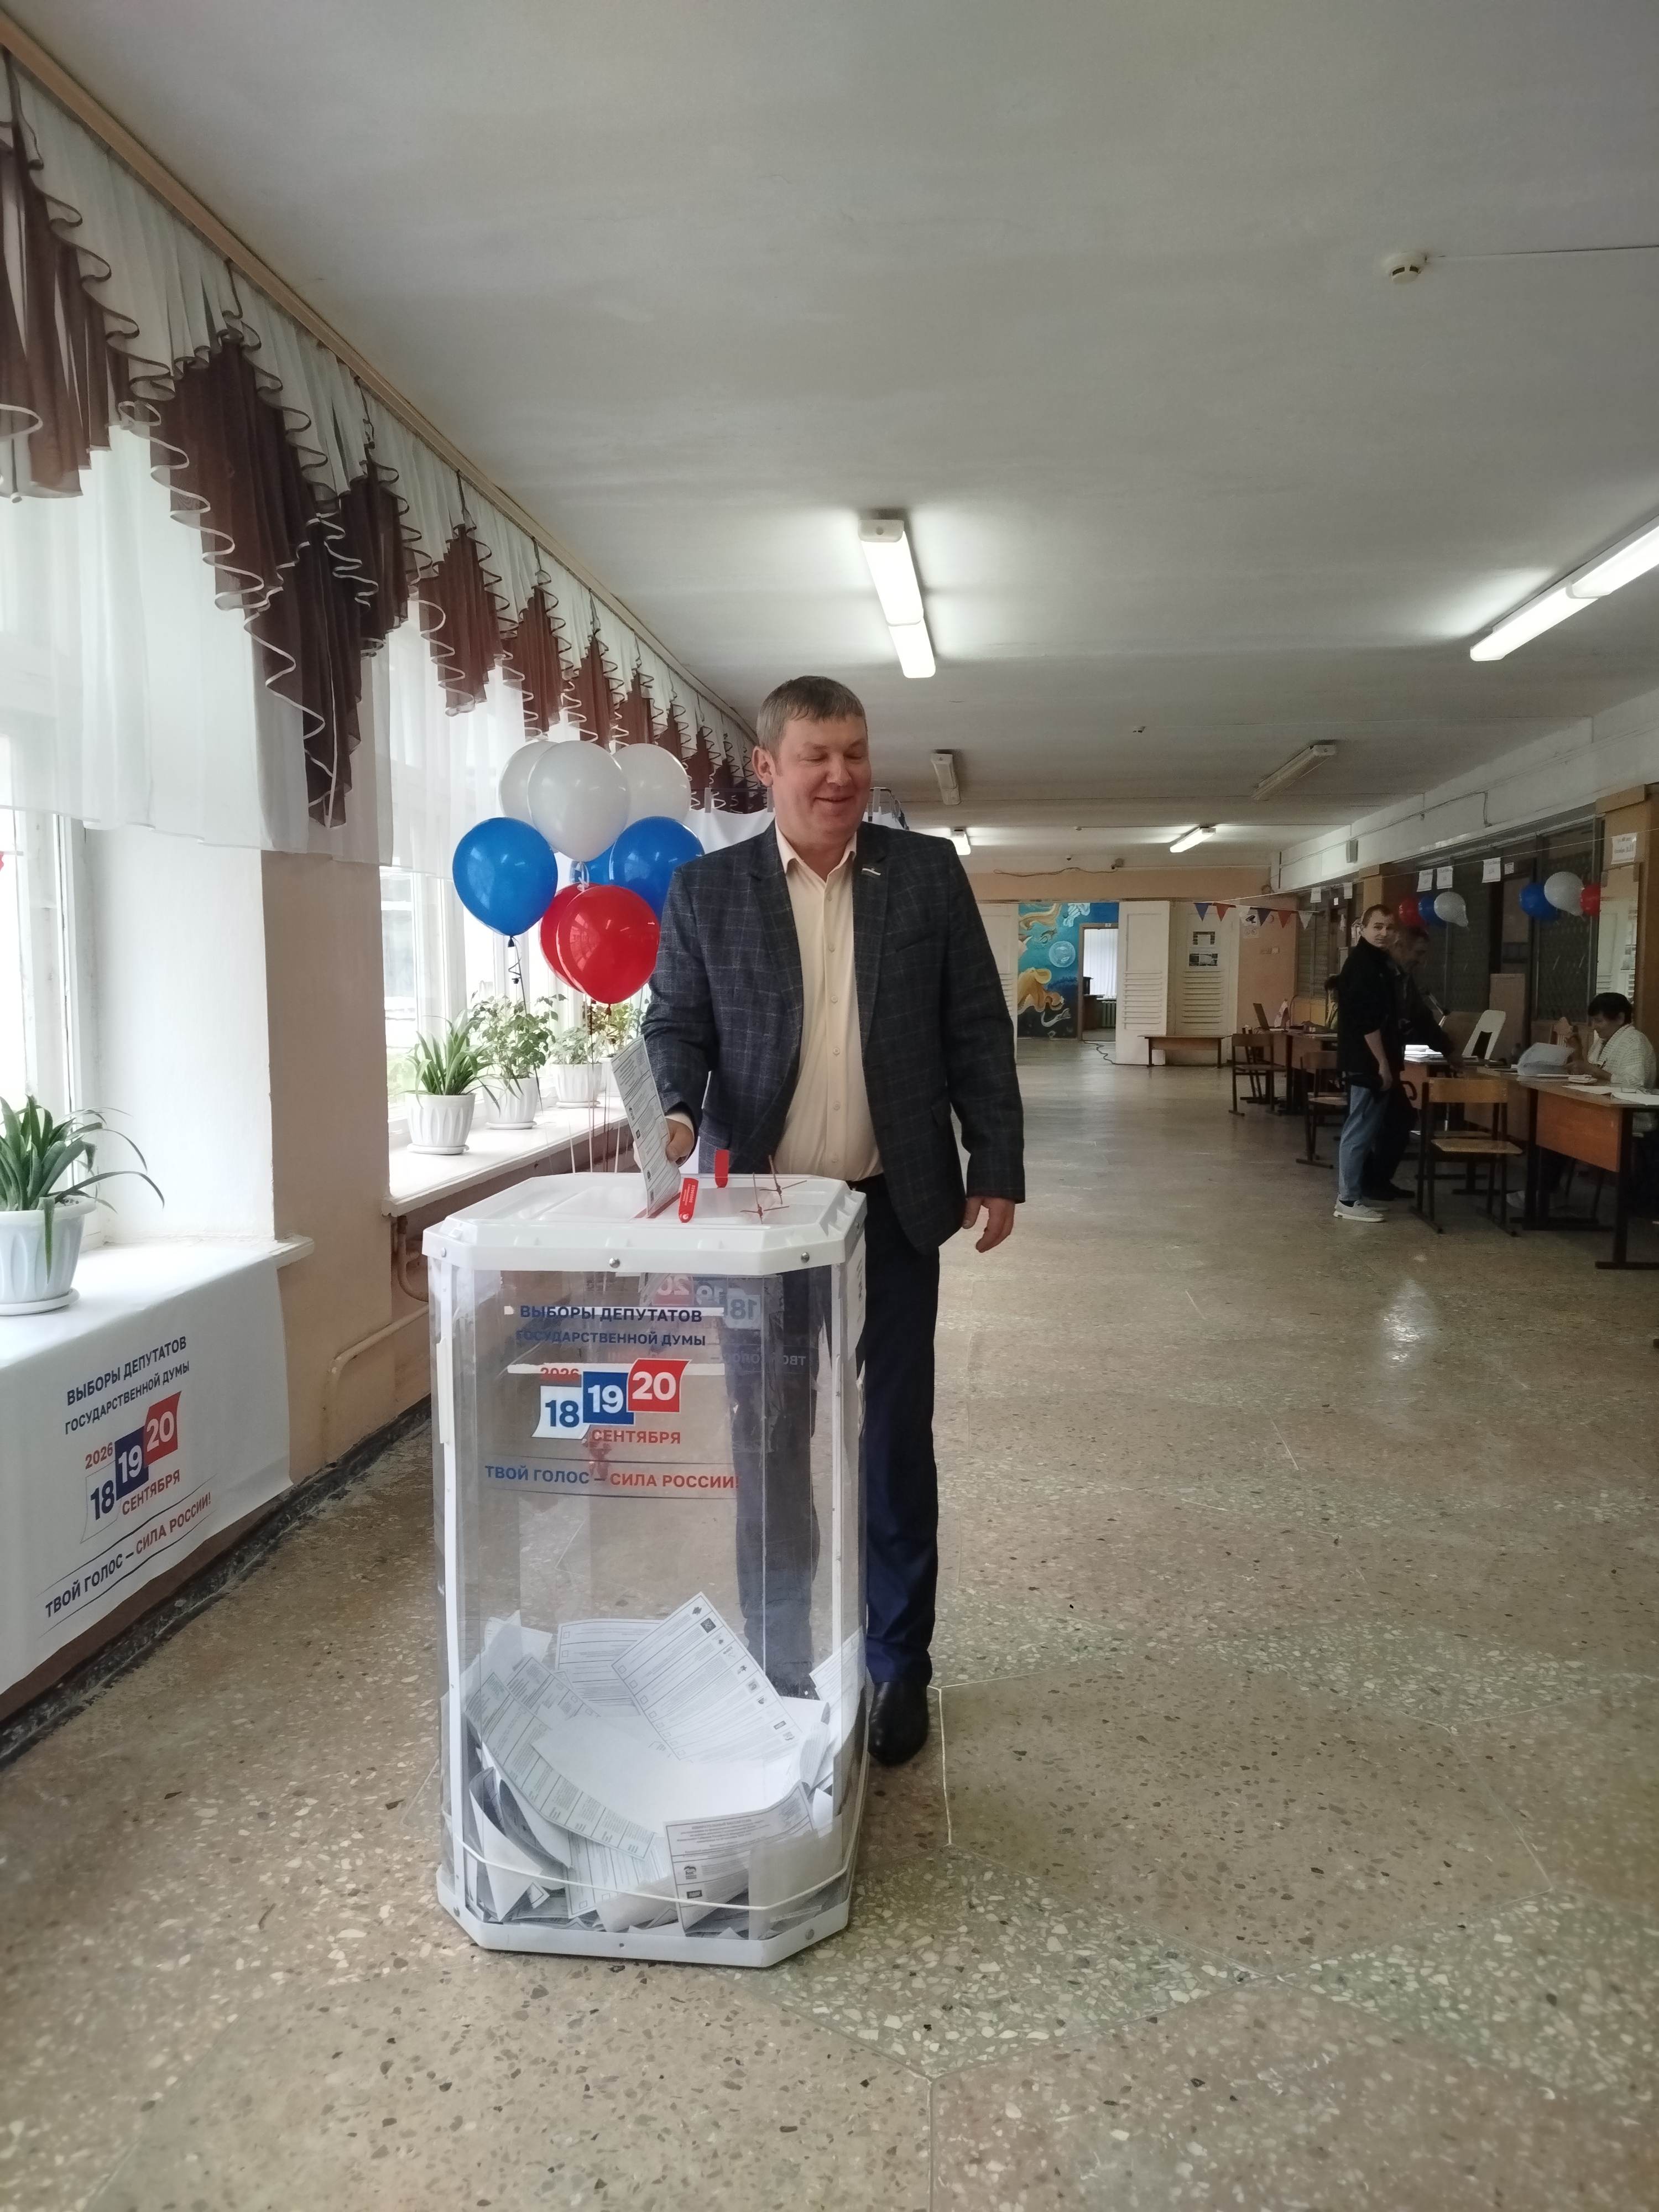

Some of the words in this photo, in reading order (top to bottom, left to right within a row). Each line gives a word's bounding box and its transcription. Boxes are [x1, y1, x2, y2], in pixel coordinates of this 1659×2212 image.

[520, 1305, 595, 1319] ВЫБОРЫ
[599, 1307, 702, 1322] ДЕПУТАТОВ
[515, 1330, 658, 1345] ГОСУДАРСТВЕННОЙ
[661, 1334, 706, 1347] ДУМЫ
[67, 1366, 121, 1406] ВЫБОРЫ
[123, 1335, 187, 1380] ДЕПУТАТОВ
[540, 1367, 580, 1380] 2026
[65, 1372, 160, 1435] ГОСУДАРСТВЕННОЙ
[162, 1360, 190, 1386] ДУМЫ
[545, 1399, 580, 1428] 18
[587, 1384, 624, 1413] 19
[632, 1371, 677, 1401] 20
[591, 1429, 681, 1444] СЕНТЯБРЯ
[85, 1442, 113, 1470] 2026
[90, 1480, 114, 1520] 18
[118, 1445, 143, 1483] 19
[146, 1411, 175, 1452] 20
[122, 1469, 180, 1515] СЕНТЯБРЯ
[484, 1465, 529, 1481] ТВОЙ
[534, 1470, 590, 1484] ГОЛОС
[610, 1472, 658, 1487] СИЛА
[662, 1474, 740, 1489] РОССИИ!
[45, 1579, 81, 1618] ТВОЙ
[84, 1553, 123, 1593] ГОЛОС
[136, 1524, 166, 1554] СИЛА
[169, 1491, 212, 1533] РОССИИ!
